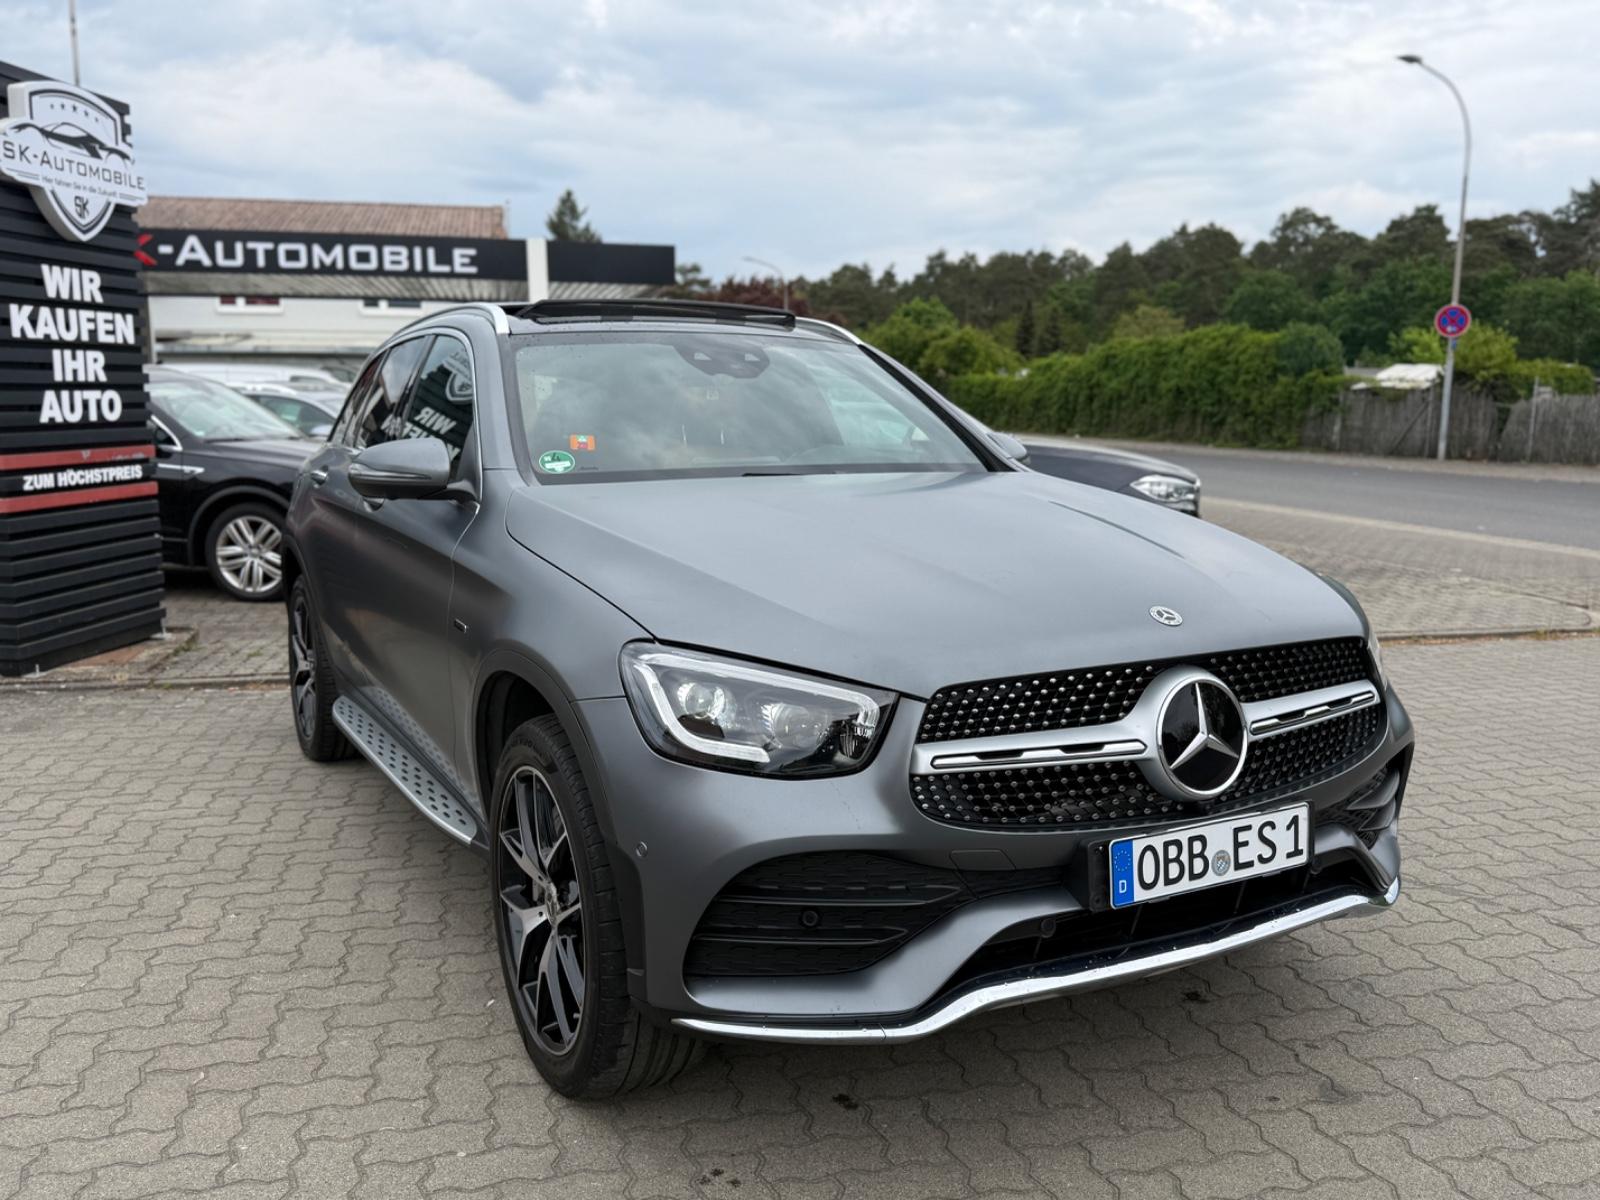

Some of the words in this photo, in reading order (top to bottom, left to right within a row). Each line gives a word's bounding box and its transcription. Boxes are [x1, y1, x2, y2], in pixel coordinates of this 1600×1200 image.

[2, 140, 146, 191] SK-AUTOMOBILE
[41, 263, 103, 303] WIR
[9, 303, 135, 345] KAUFEN
[52, 348, 107, 383] IHR
[39, 389, 122, 424] AUTO
[23, 473, 54, 491] ZUM
[57, 464, 143, 489] HÖCHSTPREIS
[1137, 833, 1210, 891] OBB
[1119, 880, 1127, 893] D
